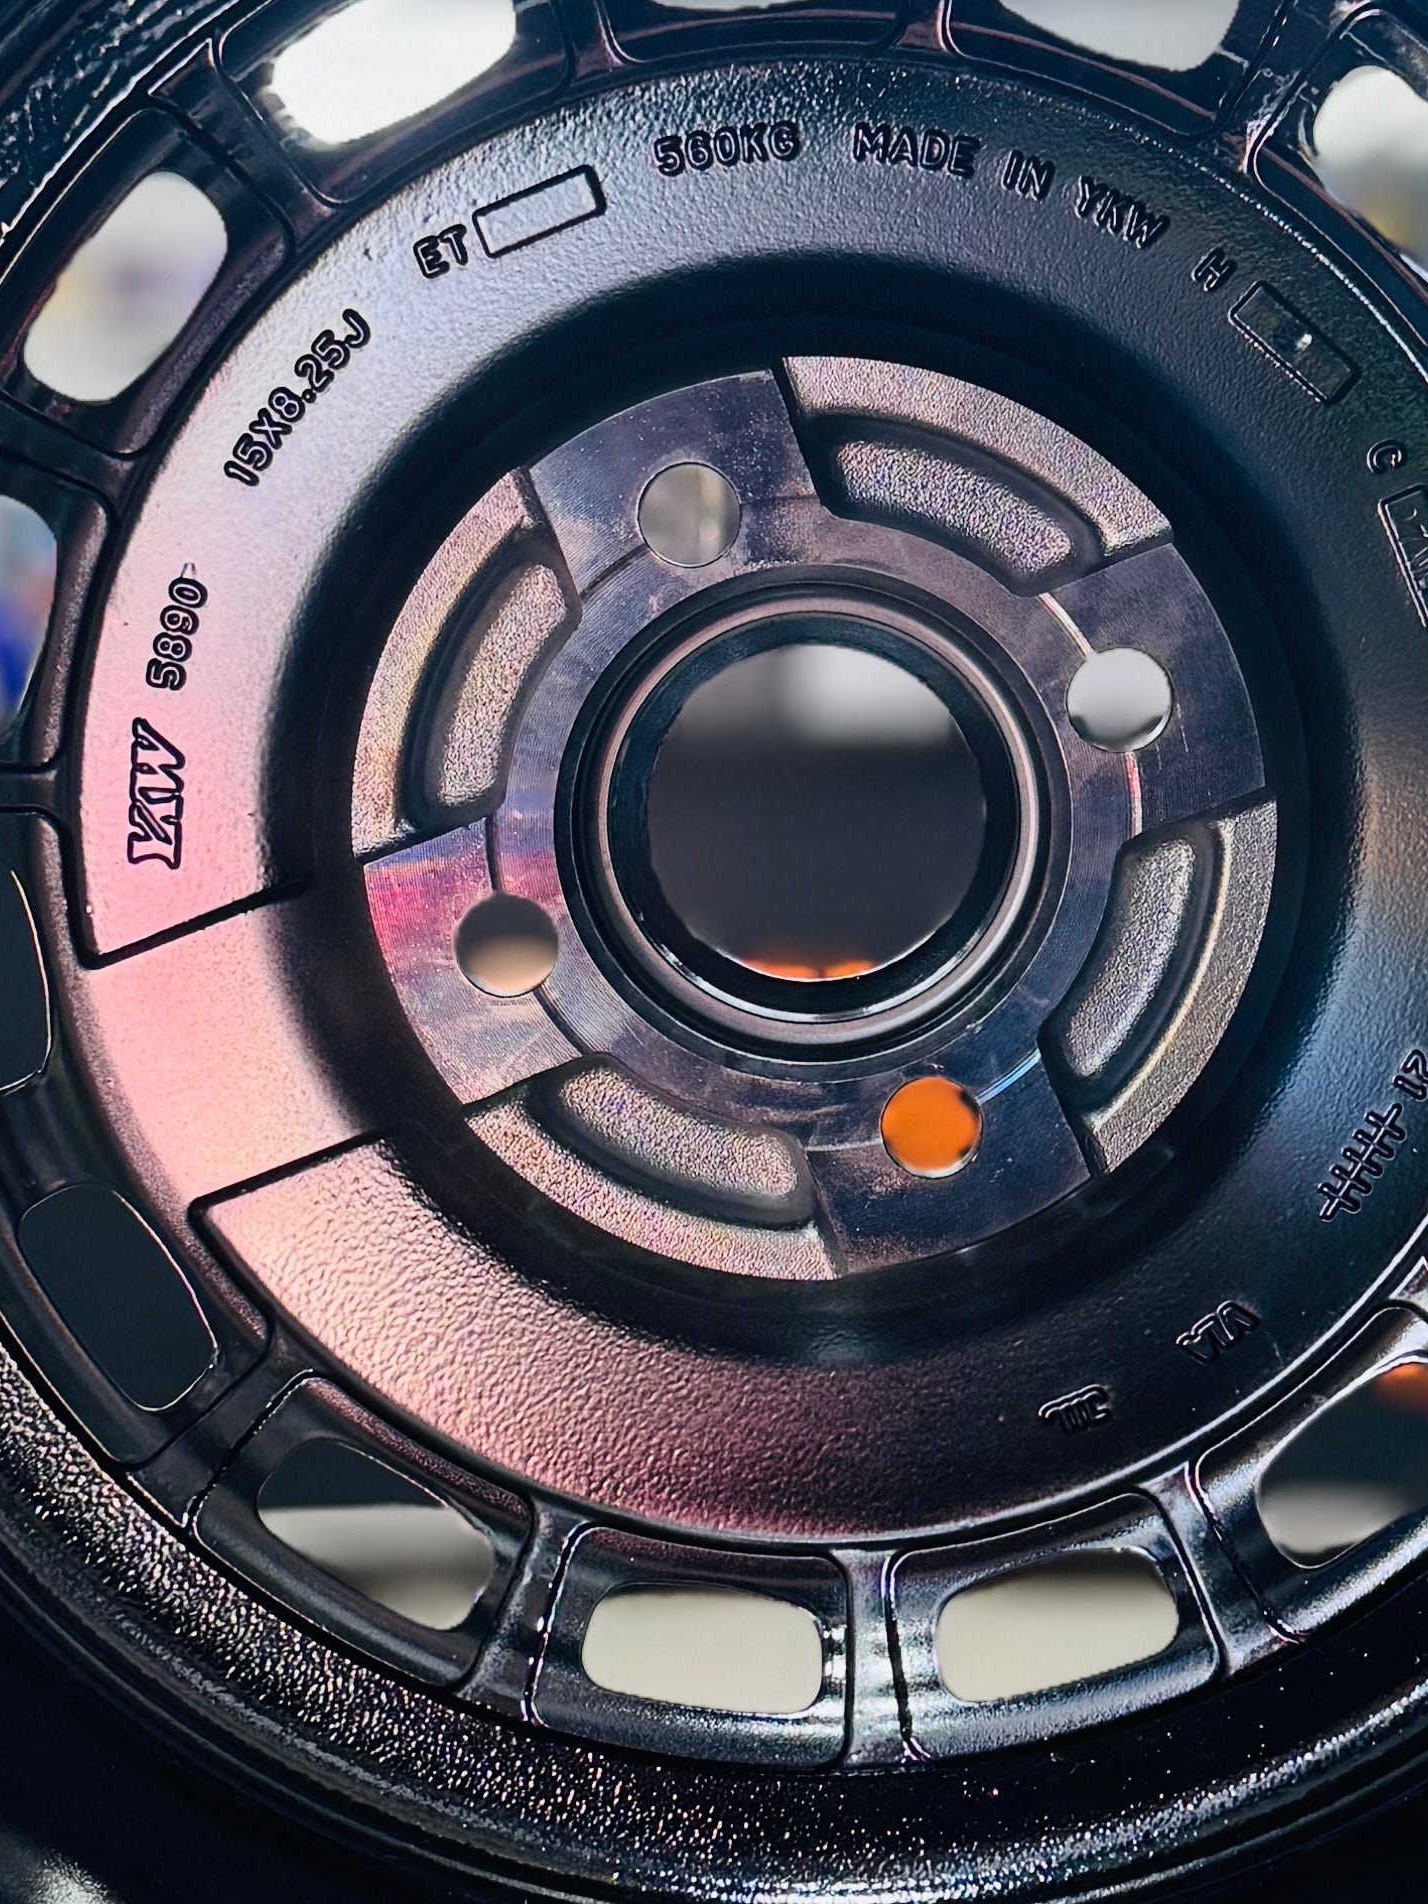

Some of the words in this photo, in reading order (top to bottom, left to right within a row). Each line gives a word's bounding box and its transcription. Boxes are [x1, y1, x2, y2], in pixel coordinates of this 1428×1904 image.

[653, 118, 802, 178] 560KG
[851, 121, 981, 179] MADE
[1002, 148, 1055, 200] IN
[1074, 174, 1170, 249] YKW
[413, 222, 472, 279] ET
[1190, 247, 1238, 292] H
[223, 308, 373, 488] 15X8.25J
[145, 576, 209, 692] 5890
